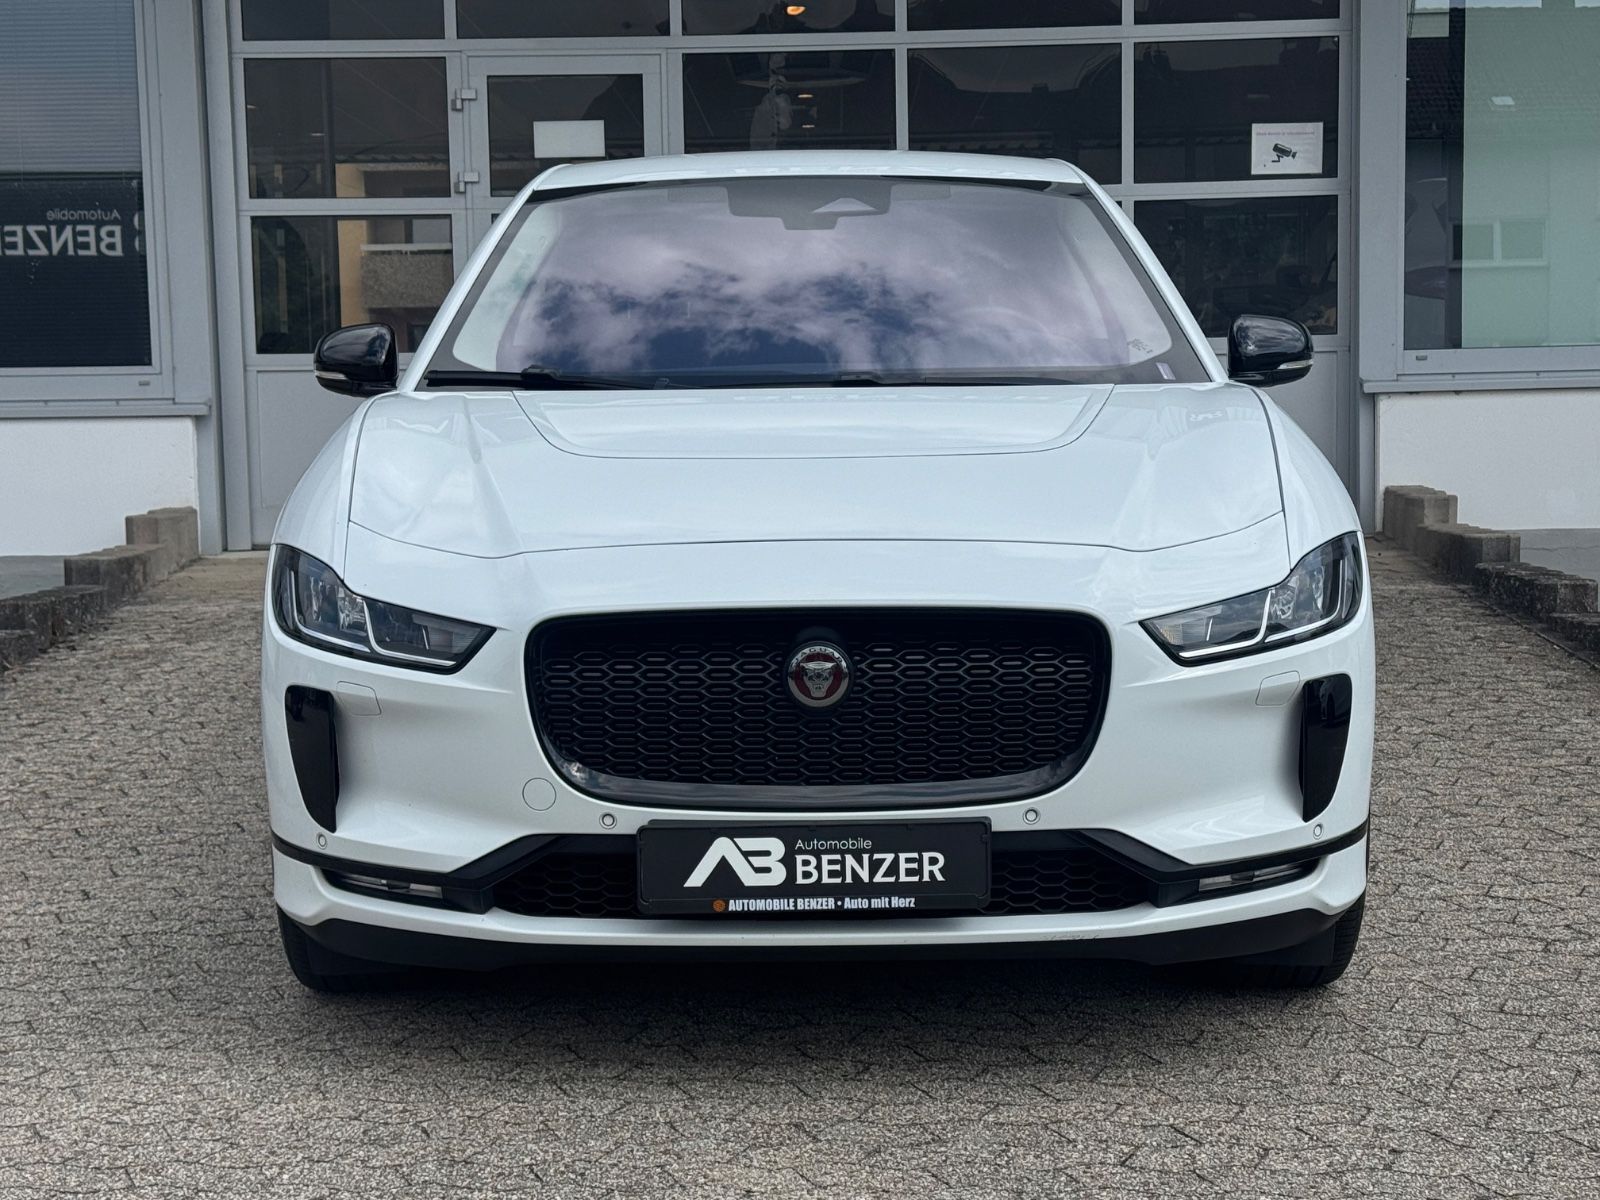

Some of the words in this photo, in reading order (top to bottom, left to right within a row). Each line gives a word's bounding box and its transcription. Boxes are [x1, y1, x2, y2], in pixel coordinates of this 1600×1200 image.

[795, 837, 872, 851] Automobile
[795, 852, 945, 884] BENZER
[728, 899, 795, 912] AUTOMOBILE
[796, 897, 835, 910] BENZER
[843, 897, 868, 909] Auto
[871, 897, 890, 908] mit
[891, 896, 916, 908] Herz
